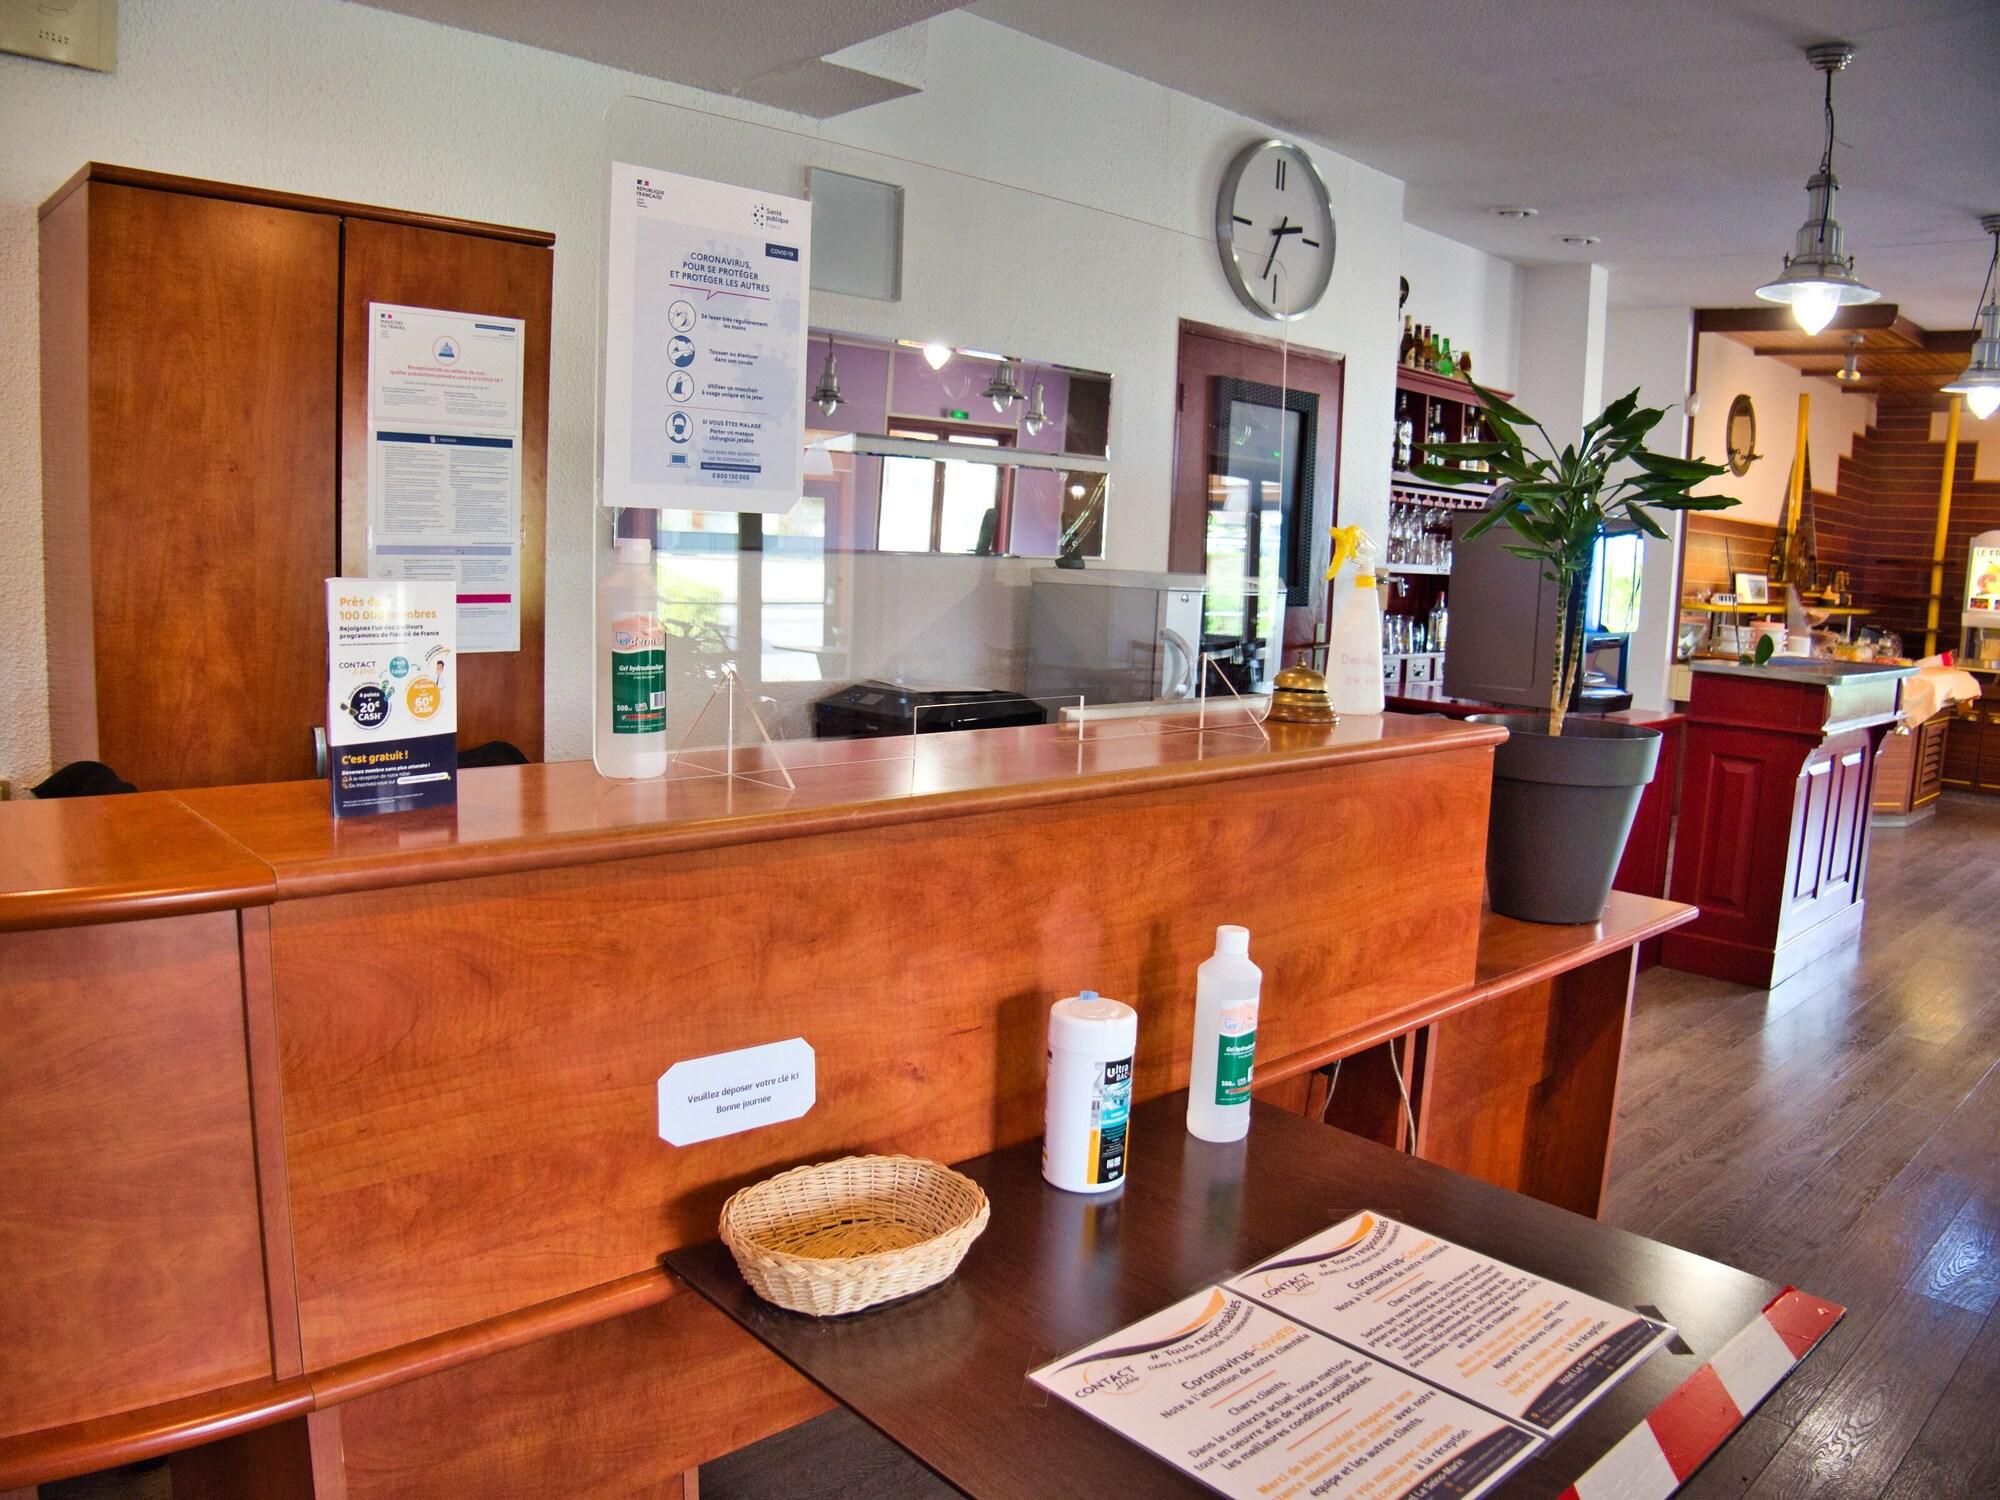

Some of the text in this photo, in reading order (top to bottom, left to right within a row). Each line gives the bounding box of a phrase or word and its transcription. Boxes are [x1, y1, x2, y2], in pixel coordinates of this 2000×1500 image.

[637, 186, 664, 195] RÉPUBLIQUE
[767, 208, 781, 216] Santé
[767, 216, 788, 224] publique
[691, 252, 751, 270] CORONAVIRUS,
[770, 248, 794, 257] COVID-19
[670, 270, 770, 292] ET PROTÉGER LES AUTRES
[683, 262, 758, 280] POUR SE PROTÉGER
[739, 422, 761, 430] MALADE
[339, 595, 365, 607] Près
[339, 610, 360, 620] 100
[339, 661, 376, 669] CONTACT
[360, 701, 380, 713] 20€
[415, 695, 433, 707] 60€
[358, 712, 381, 721] CASH
[342, 750, 408, 765] C'est gratuit !
[1107, 1064, 1129, 1078] Ultra
[1116, 1072, 1128, 1082] BAC
[687, 1071, 800, 1104] Veuillez déposer votre clé ici
[716, 1094, 772, 1114] Bonne journée
[1331, 1220, 1389, 1267] Tous responsables
[1262, 1272, 1311, 1298] CONTACT
[1334, 1300, 1355, 1311] Note
[1357, 1276, 1395, 1297] l'attention
[1403, 1260, 1422, 1272] notre
[1386, 1294, 1411, 1307] Chers
[1150, 1299, 1242, 1361] # Tous responsables
[1233, 1305, 1255, 1335] CORONAVIRUS
[1182, 1327, 1294, 1389] Coronavirus-Covid19
[1075, 1365, 1136, 1398] CONTACT
[1160, 1403, 1186, 1418] Note
[1191, 1373, 1240, 1400] l'attention
[1239, 1366, 1252, 1375] de
[1251, 1353, 1276, 1368] notre
[1274, 1333, 1310, 1354] clientèle
[1187, 1359, 1351, 1457] Dans le contexte actuel, nous mettons
[1227, 1399, 1257, 1415] Chers
[1393, 1406, 1415, 1420] avec
[1412, 1390, 1436, 1407] notre
[1193, 1361, 1372, 1470] tout en oeuvre afin de vous accueillir dans
[1221, 1376, 1371, 1470] les meilleures conditions possibles.
[1257, 1473, 1288, 1494] Merci
[1287, 1465, 1303, 1476] de
[1298, 1451, 1324, 1466] bien
[1323, 1429, 1355, 1451] vouloir
[1355, 1401, 1396, 1430] respecter
[1310, 1418, 1423, 1496] équipe et les autres clients.
[1418, 1456, 1434, 1465] la
[1431, 1429, 1470, 1457] réception.
[1355, 1481, 1375, 1495] vos
[1373, 1464, 1398, 1482] main
[1395, 1449, 1418, 1466] avec
